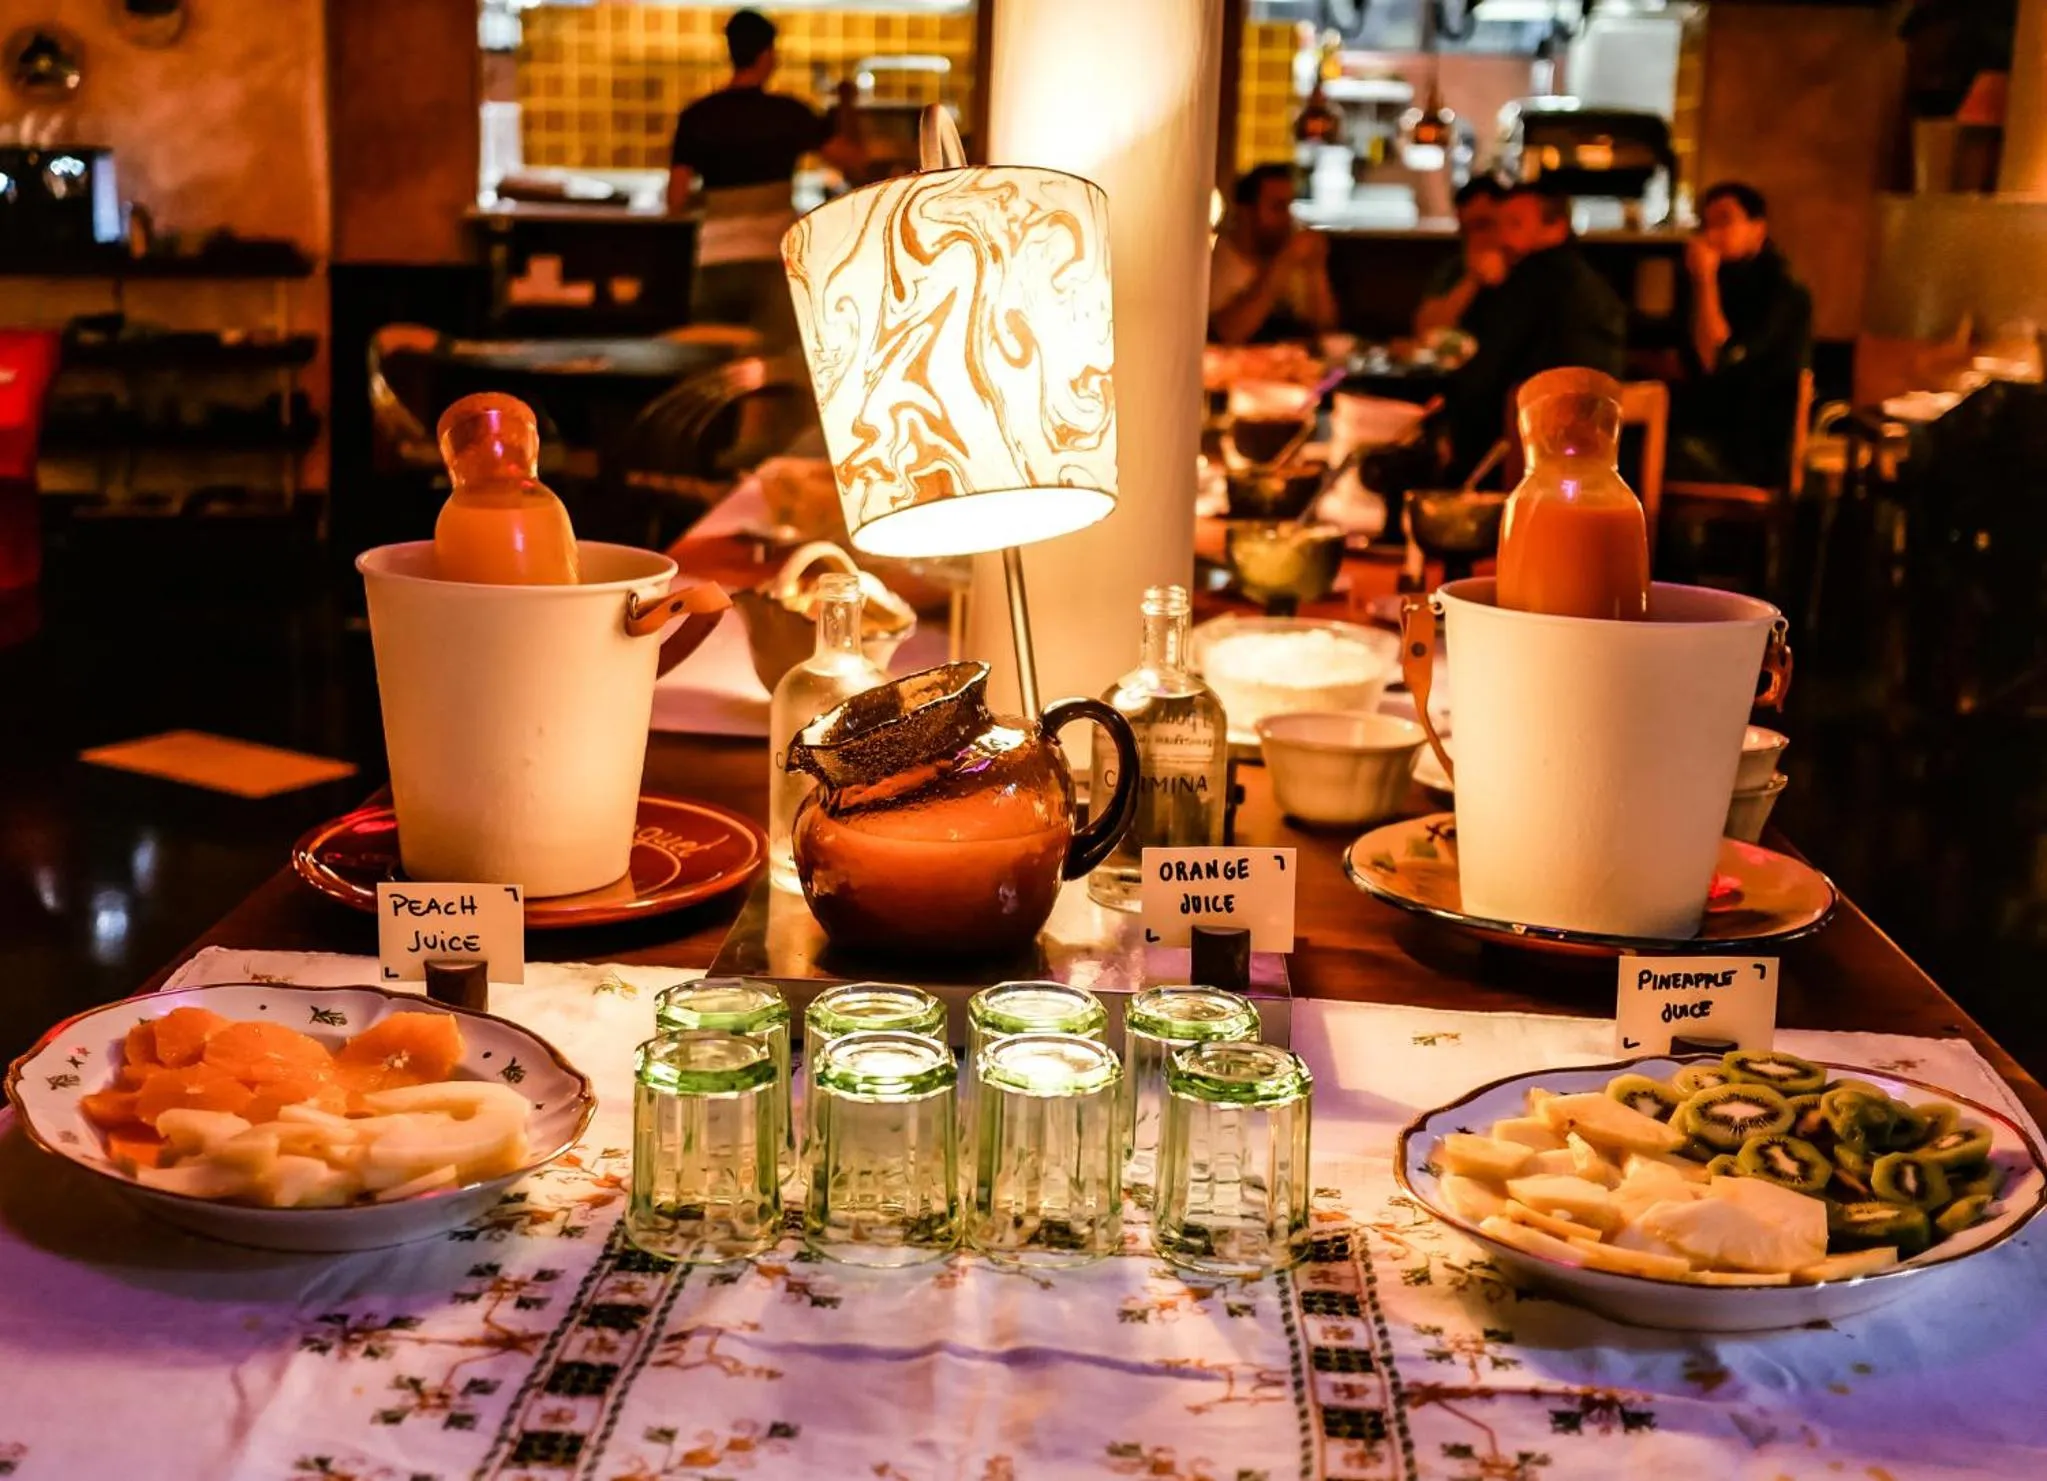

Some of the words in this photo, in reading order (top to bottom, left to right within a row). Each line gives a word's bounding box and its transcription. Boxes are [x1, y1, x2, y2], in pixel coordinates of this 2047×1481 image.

[1104, 769, 1208, 794] CMINA
[1159, 858, 1250, 882] ORANGE
[388, 893, 478, 917] PEACH
[1180, 893, 1235, 915] JUICE
[1637, 968, 1738, 991] PINEAPPLE
[1661, 1000, 1714, 1023] JUICE
